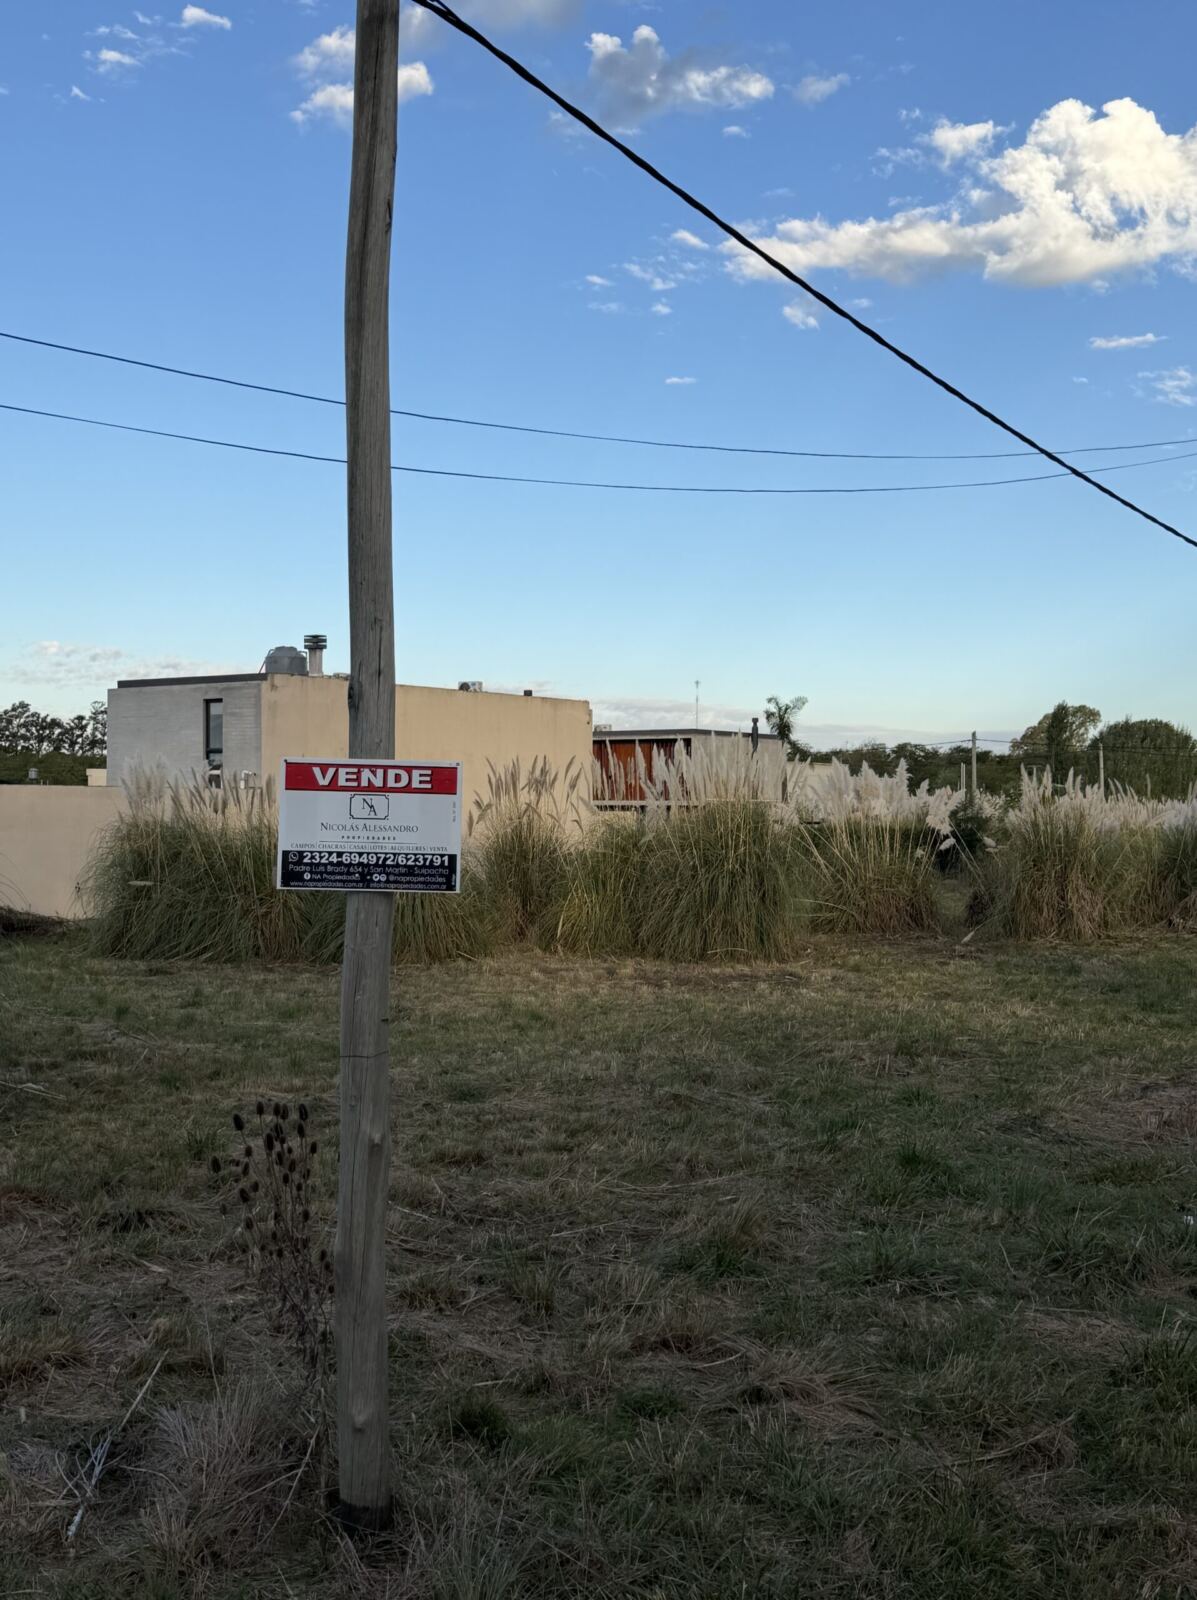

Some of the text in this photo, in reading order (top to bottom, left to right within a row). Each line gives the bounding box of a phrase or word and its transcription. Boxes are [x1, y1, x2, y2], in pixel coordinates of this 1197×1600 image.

[312, 767, 432, 789] VENDE
[362, 823, 418, 833] ALESSANDRO
[303, 852, 449, 866] 2324-694972/623791
[289, 864, 310, 872] Padre
[389, 874, 446, 882] @napropiedades
